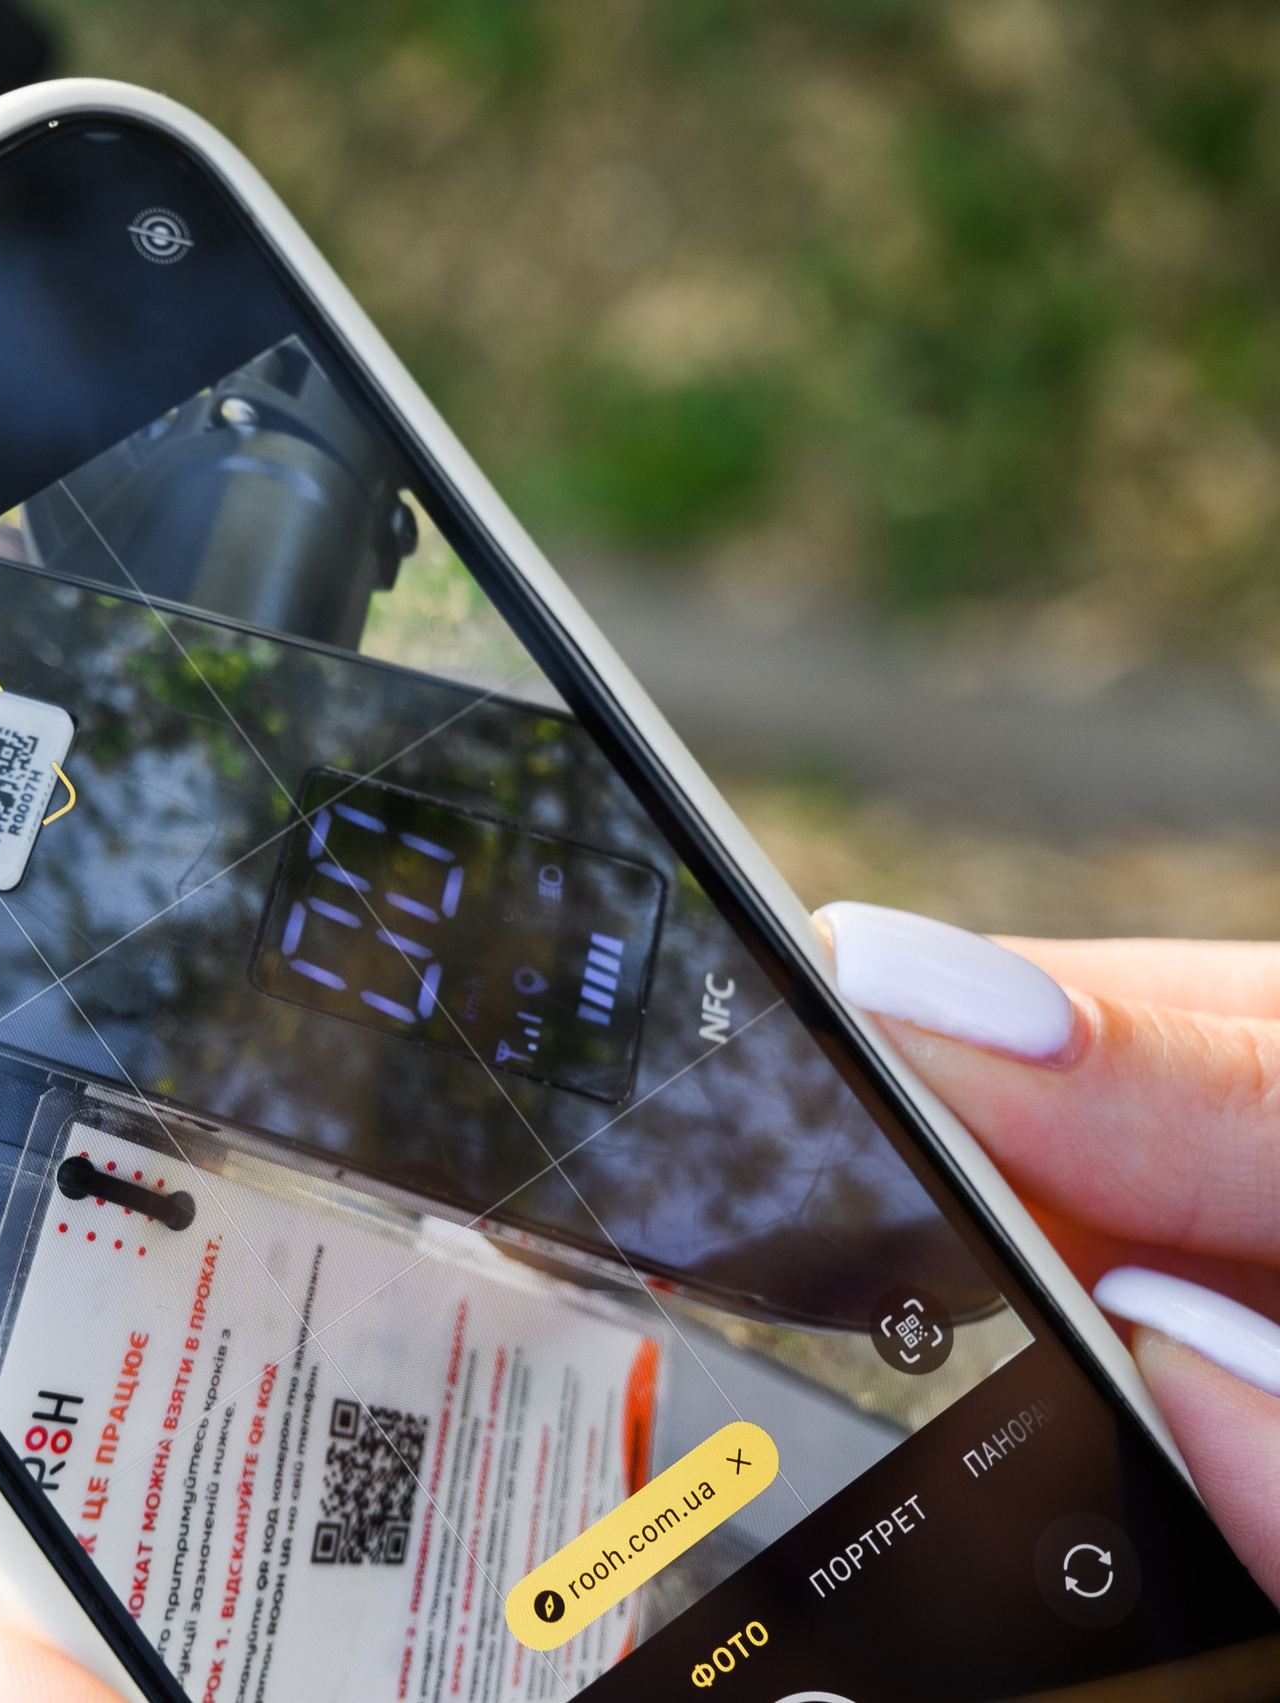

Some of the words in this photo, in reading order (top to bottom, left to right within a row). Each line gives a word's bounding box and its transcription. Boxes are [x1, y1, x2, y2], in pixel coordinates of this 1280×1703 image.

[7, 770, 42, 836] R0007H
[698, 973, 735, 1043] NFC
[190, 1236, 222, 1330] ПРОКАТ.
[185, 1337, 199, 1351] В
[82, 1478, 108, 1520] ЦЕ
[95, 1332, 148, 1464] ПРАЦЮЄ
[163, 1358, 194, 1430] ВЗЯТИ
[142, 1440, 172, 1531] МОЖНА
[156, 1628, 170, 1659] го
[164, 1418, 209, 1621] притримуйтесь
[204, 1345, 227, 1411] кроків
[191, 1482, 219, 1612] зазначеній
[213, 1404, 235, 1475] нижче.
[221, 1454, 258, 1619] ВІДСКАНУЙТЕ
[249, 1415, 265, 1446] QR
[257, 1364, 278, 1409] КОД
[568, 1479, 716, 1599] rooh.com.ua
[808, 1494, 926, 1598] ПОРТРЕТ
[690, 1621, 769, 1689] ФОТО
